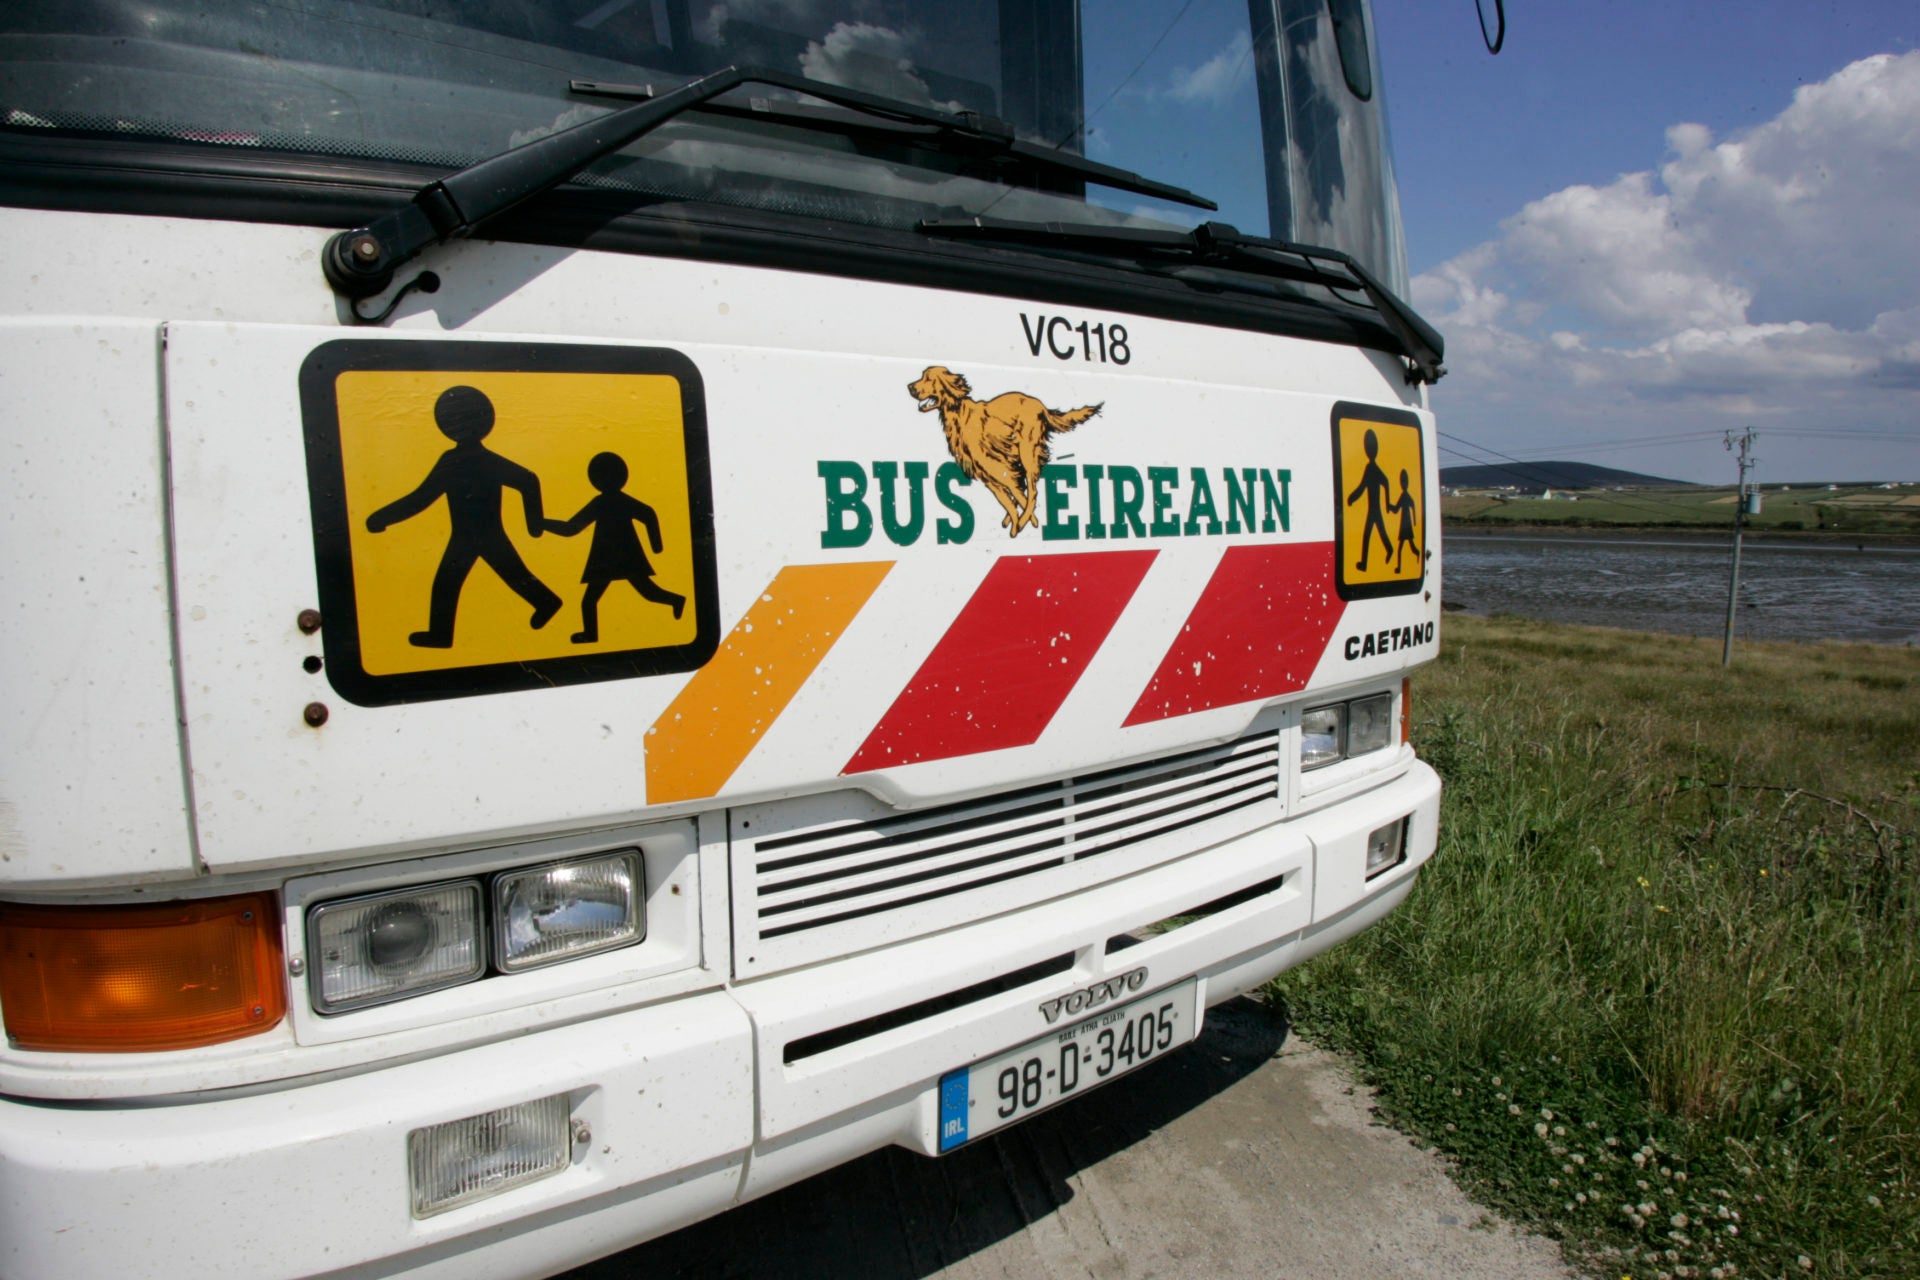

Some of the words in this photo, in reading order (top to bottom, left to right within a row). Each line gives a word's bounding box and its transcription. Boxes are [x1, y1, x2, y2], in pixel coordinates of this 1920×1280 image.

[1020, 312, 1131, 366] VC118
[817, 460, 975, 549] BUS
[1345, 621, 1434, 661] CAETANO
[1039, 966, 1149, 1025] VOLVO
[997, 1002, 1174, 1119] 98-D-3405
[944, 1117, 965, 1139] IRL
